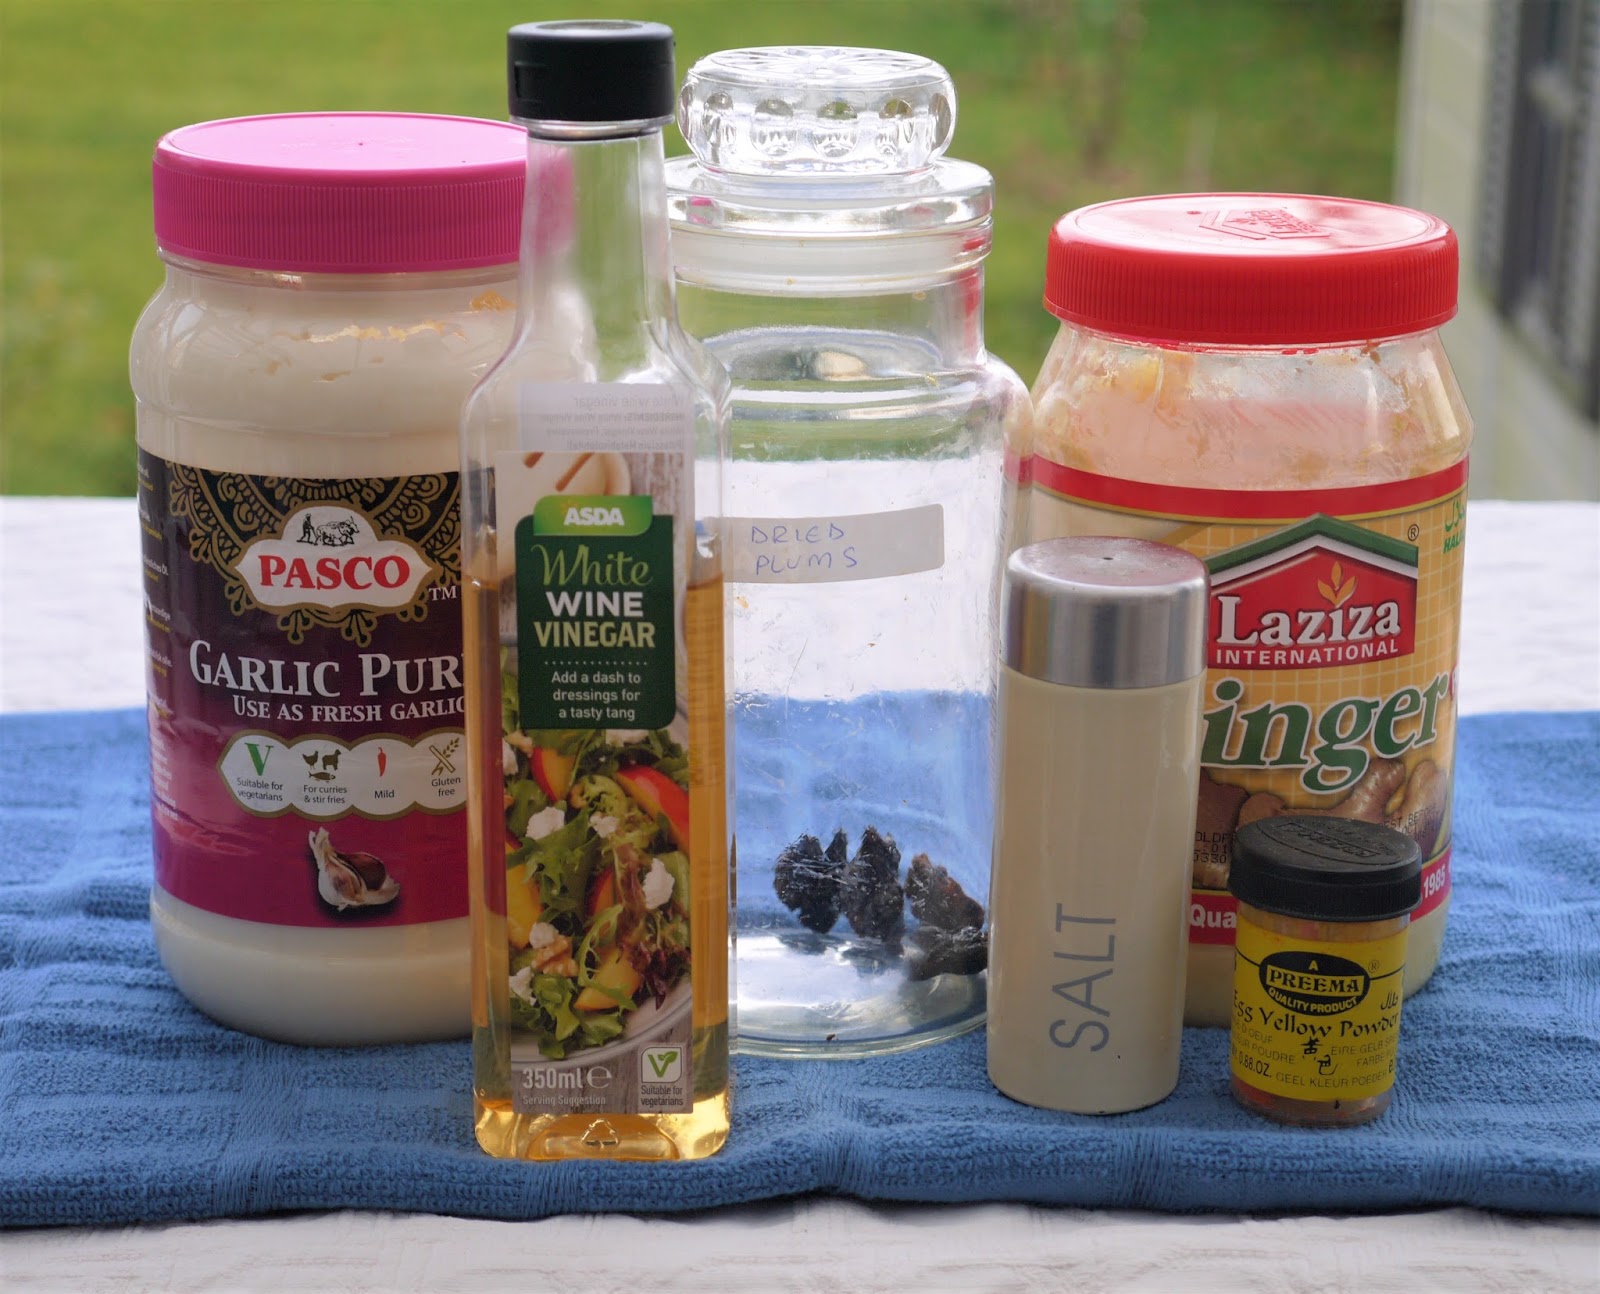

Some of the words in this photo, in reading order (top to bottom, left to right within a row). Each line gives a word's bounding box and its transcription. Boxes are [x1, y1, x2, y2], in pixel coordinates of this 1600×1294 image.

[563, 507, 625, 527] ASDA
[751, 522, 845, 544] DRIED
[530, 544, 653, 586] White
[756, 546, 858, 576] PLUMS
[258, 555, 410, 590] PASCO
[428, 587, 457, 601] TM
[546, 591, 644, 618] WINE
[1215, 596, 1402, 647] Laziza
[533, 621, 656, 648] VINEGAR
[1216, 640, 1399, 665] INTERNATIONAL
[189, 639, 341, 698] GARLIC
[358, 652, 465, 697] PUR
[551, 671, 577, 684] Add
[581, 674, 589, 684] a
[592, 671, 626, 684] dash
[628, 672, 641, 684] to
[552, 689, 619, 704] dressings
[621, 689, 641, 701] for
[232, 695, 271, 719] USE
[277, 705, 304, 722] AS
[311, 705, 382, 722] FRESH
[559, 709, 567, 718] a
[570, 707, 603, 721] tasty
[606, 707, 636, 721] tang
[1200, 672, 1449, 792] inger
[237, 777, 270, 791] Suitable
[271, 781, 284, 791] for
[303, 784, 318, 794] For
[319, 785, 348, 794] curries
[431, 777, 461, 787] Gluten
[438, 788, 456, 797] free
[238, 790, 283, 802] vegetarians
[304, 795, 311, 803] &
[312, 795, 326, 803] stir
[327, 795, 346, 803] fries
[374, 790, 395, 799] Mild
[1423, 864, 1446, 898] 1985
[1308, 960, 1319, 971] A
[1049, 903, 1117, 1052] SALT
[1268, 968, 1360, 993] PREEMA
[1268, 987, 1310, 1012] QUALITY
[1310, 996, 1358, 1013] PRODUCT
[1259, 1007, 1332, 1037] Yellow
[1340, 1012, 1399, 1038] Powder
[1252, 1043, 1296, 1065] POUDRE
[522, 1067, 583, 1089] 350ml
[1276, 1072, 1306, 1087] GEEL
[1310, 1077, 1349, 1088] KLEUR
[522, 1095, 556, 1106] Serving
[557, 1095, 606, 1106] Suggestion
[640, 1085, 671, 1095] Suitable
[673, 1085, 683, 1095] for
[641, 1097, 684, 1107] vegetarians
